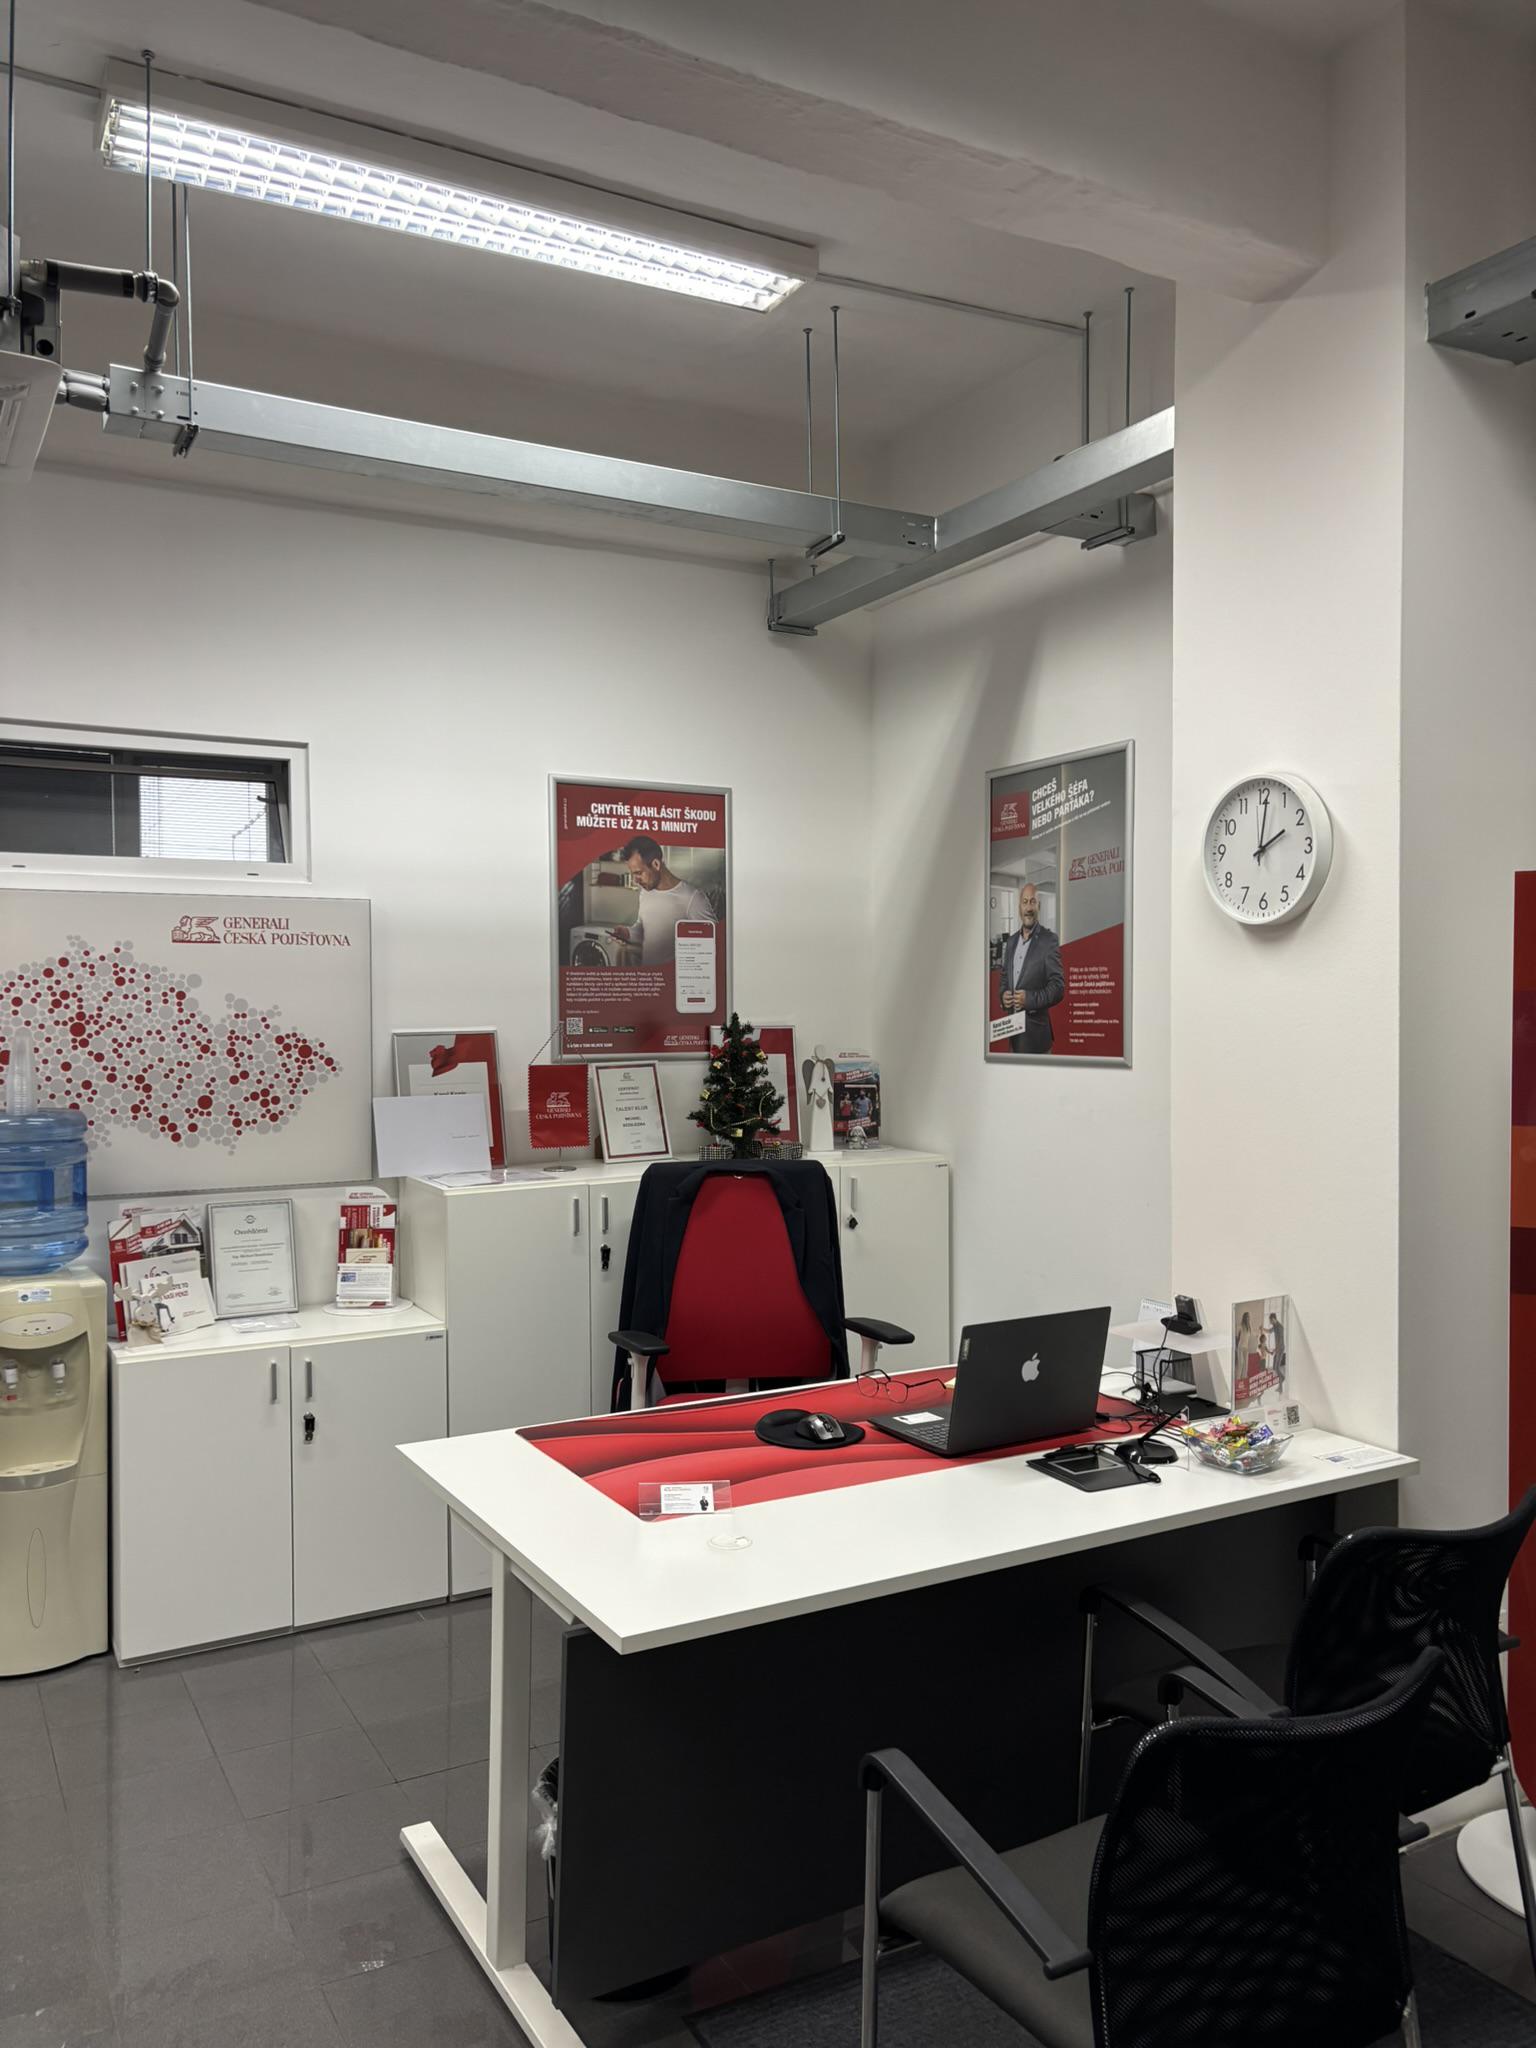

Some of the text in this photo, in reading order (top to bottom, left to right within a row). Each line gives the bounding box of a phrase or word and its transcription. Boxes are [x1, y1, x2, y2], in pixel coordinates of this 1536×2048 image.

[1032, 777, 1057, 802] CHCEŠ
[1032, 779, 1088, 816] VELKÉHO ŠÉFA
[1258, 787, 1270, 805] 12
[1239, 798, 1248, 815] 11
[1282, 792, 1287, 808] 1
[591, 802, 717, 822] CHYTŘE NAHLÁSIT ŠKODU
[1032, 811, 1052, 830] NEBO
[1054, 790, 1095, 820] PARŤÁKA?
[1295, 808, 1305, 826] 2
[576, 813, 698, 833] MŮŽETE UŽ ZA 3 MINUTY
[1224, 818, 1237, 836] 10
[1217, 844, 1226, 862] 9
[1304, 836, 1313, 854] 3
[1087, 847, 1120, 865] GENERALI
[1087, 863, 1107, 877] ČESKÁ
[1295, 863, 1305, 880] 4
[1225, 872, 1233, 888] 8
[1241, 886, 1250, 904] 7
[1259, 892, 1268, 910] 6
[1280, 885, 1289, 902] 5
[223, 916, 290, 930] GENERALI
[223, 930, 351, 947] ČESKÁ POJIŠŤOVNA
